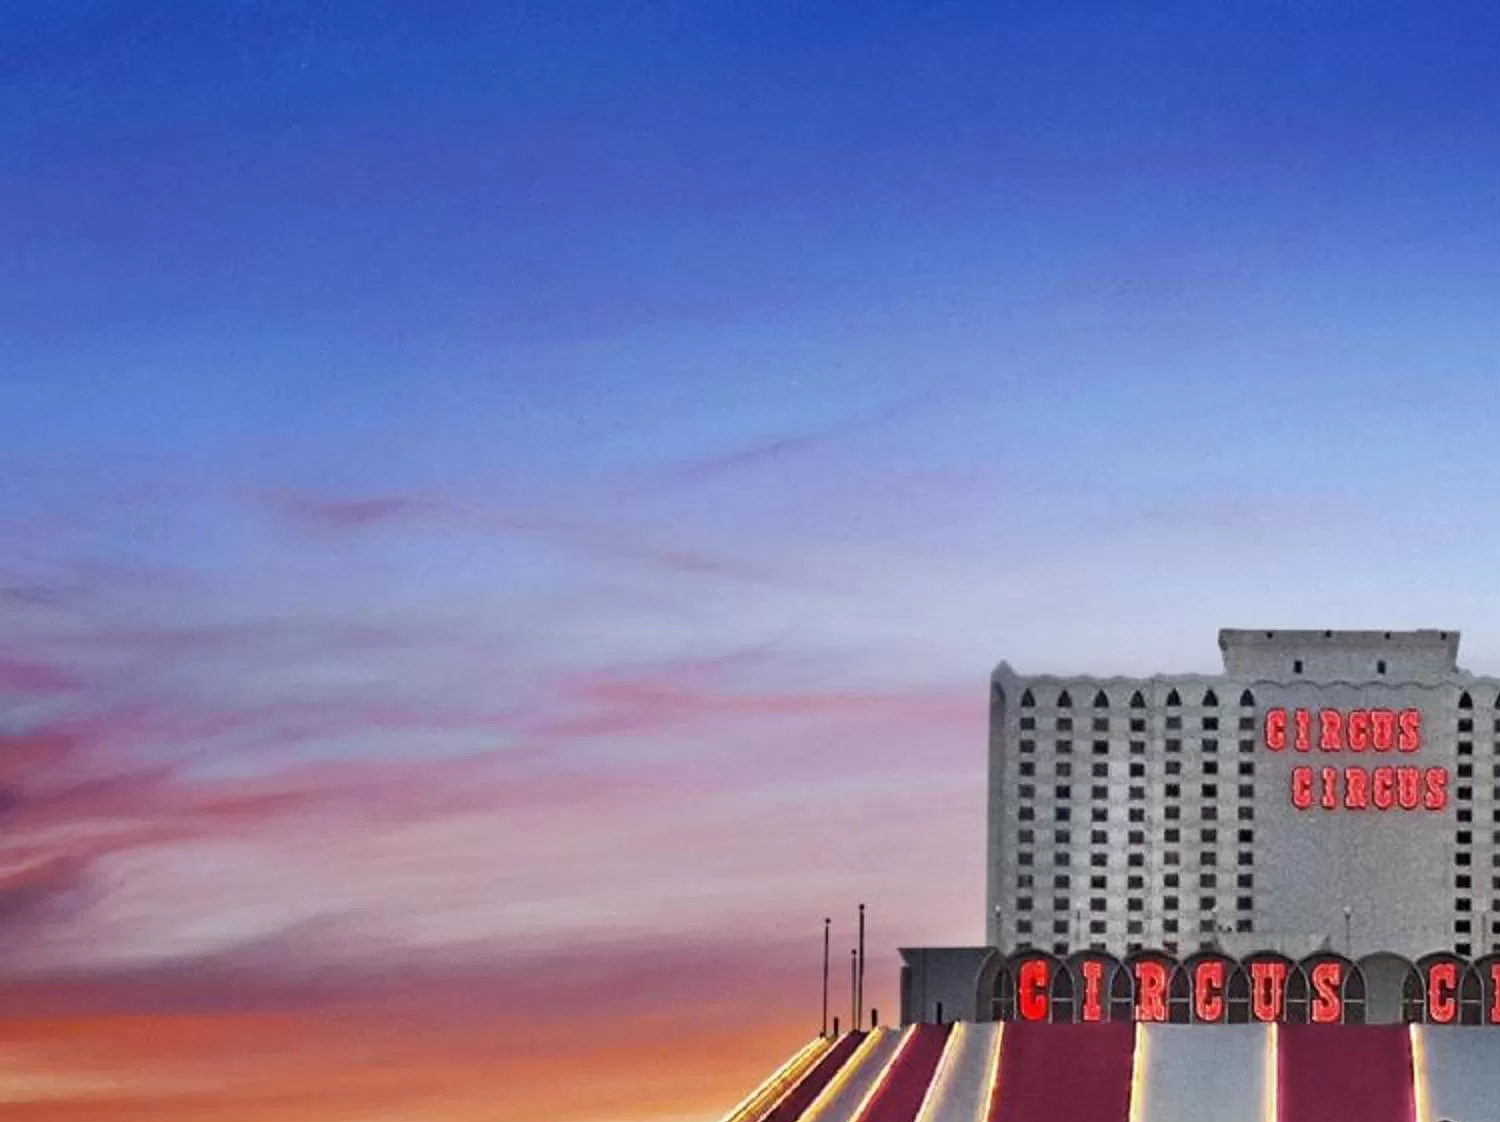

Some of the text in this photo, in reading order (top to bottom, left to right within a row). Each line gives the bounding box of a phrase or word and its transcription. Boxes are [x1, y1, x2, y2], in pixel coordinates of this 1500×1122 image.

[1264, 708, 1422, 753] CIRCUS
[1292, 767, 1450, 811] CIRCUS
[1018, 960, 1341, 1023] CIRCUS
